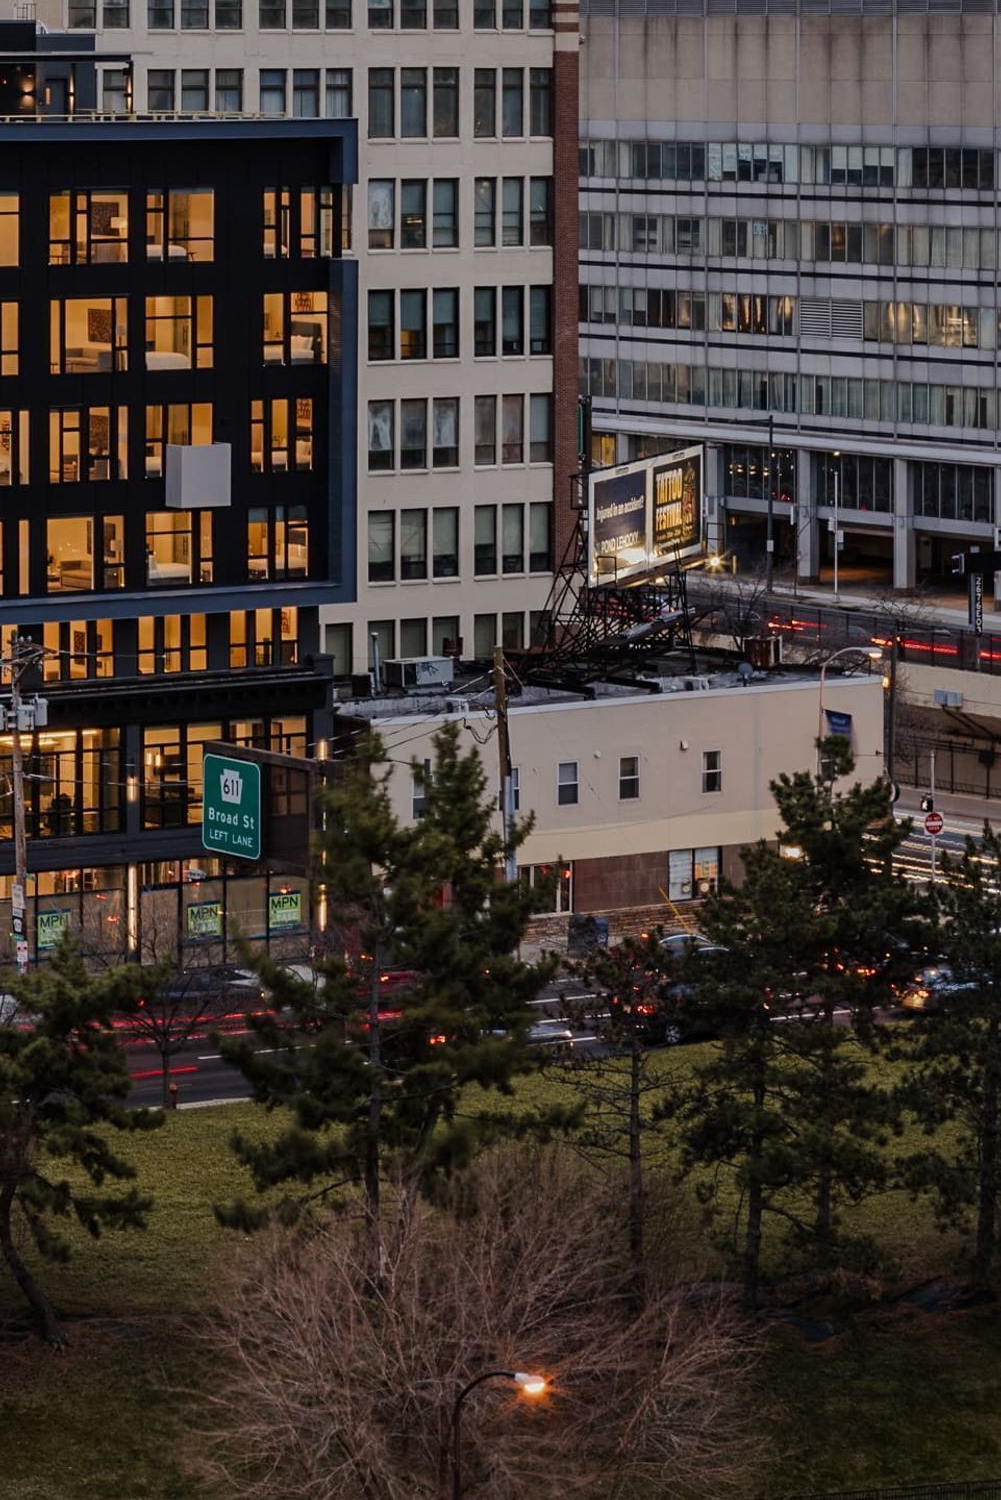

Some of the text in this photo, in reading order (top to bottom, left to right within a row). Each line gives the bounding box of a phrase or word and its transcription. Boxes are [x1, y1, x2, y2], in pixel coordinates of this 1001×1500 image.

[656, 467, 682, 505] TATTOO
[596, 502, 612, 523] Injured
[656, 501, 682, 533] FESTIVAL
[601, 537, 616, 554] POND
[223, 778, 239, 797] 611
[208, 806, 255, 829] Broad St
[209, 828, 253, 848] LEFT LANE
[190, 906, 218, 920] MPN
[271, 896, 298, 910] MPN
